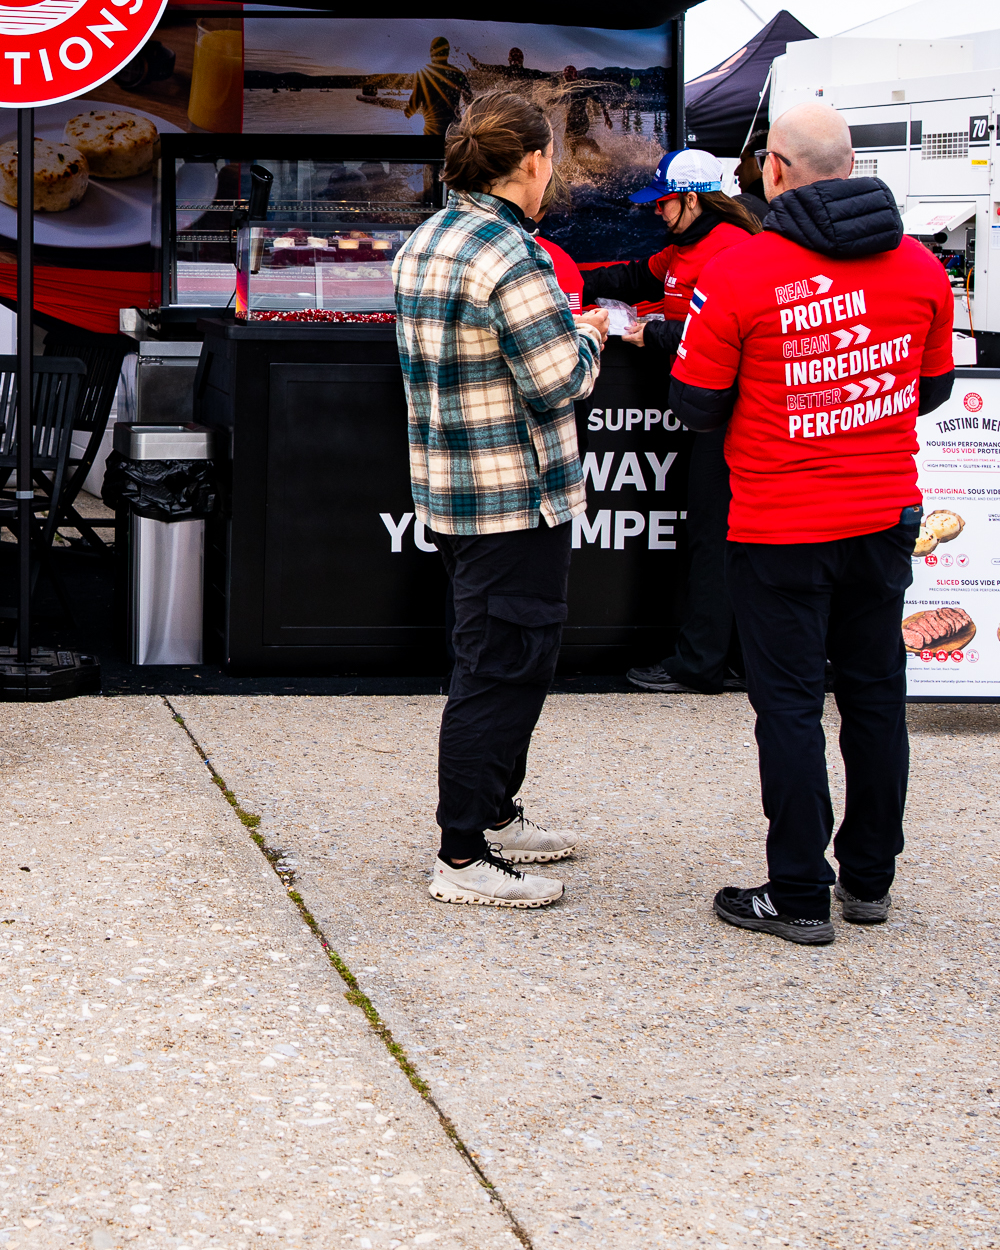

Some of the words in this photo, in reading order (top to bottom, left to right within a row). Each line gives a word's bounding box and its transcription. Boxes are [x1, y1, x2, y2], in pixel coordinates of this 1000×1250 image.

[972, 119, 987, 138] 70
[775, 279, 813, 305] REAL
[779, 289, 867, 334] PROTEIN
[782, 333, 831, 359] CLEAN
[784, 333, 912, 387] INGREDIENTS
[786, 387, 842, 411] BETTER
[788, 378, 917, 439] PERFORMANCE
[936, 417, 979, 434] TASTING
[582, 451, 679, 491] WAY
